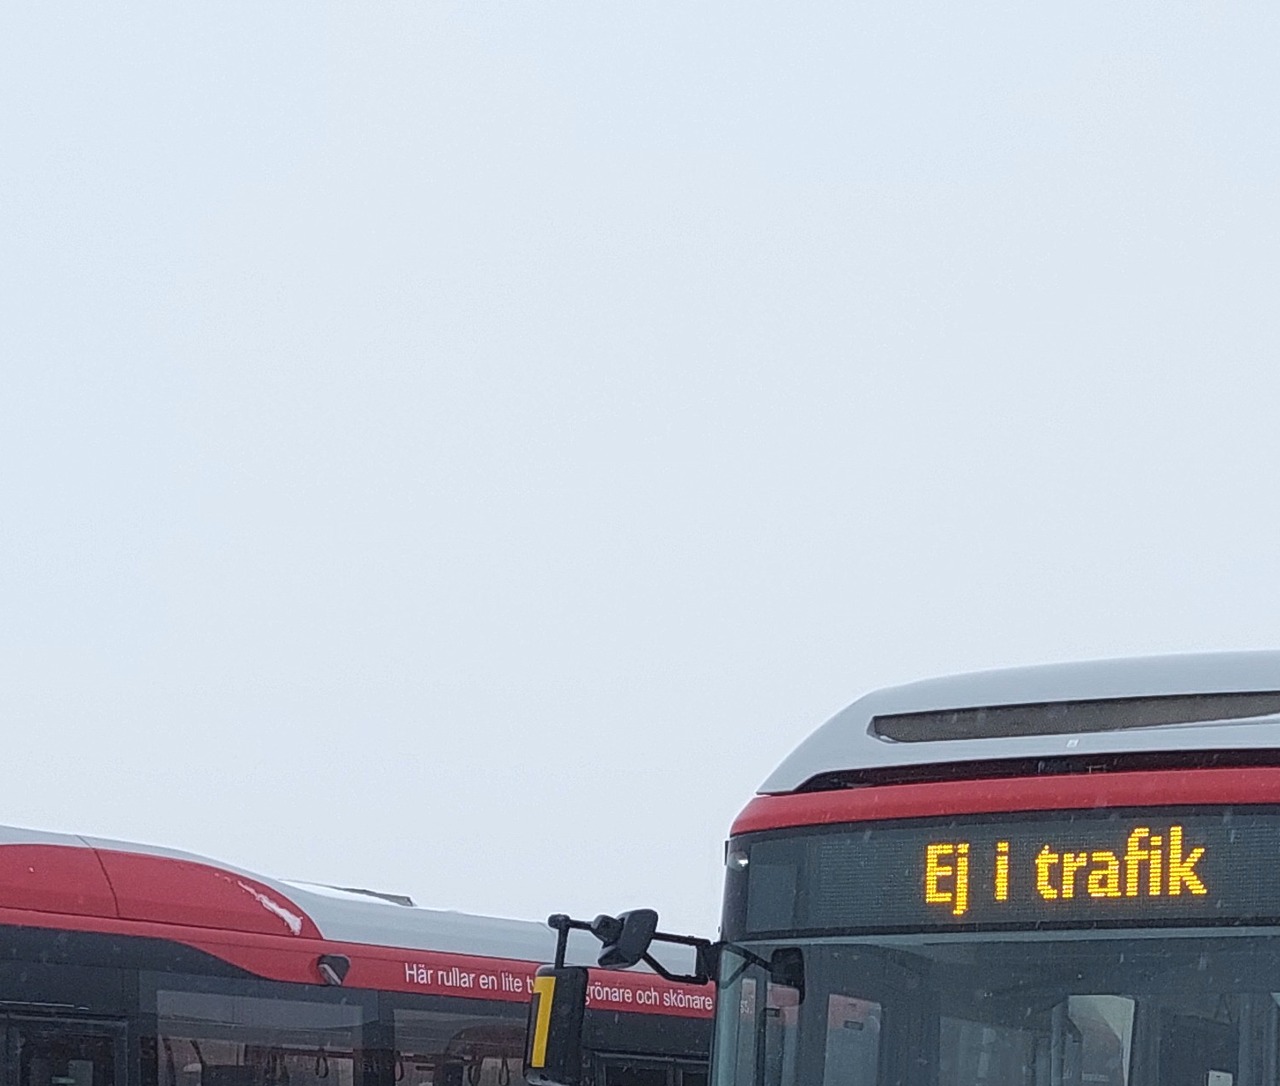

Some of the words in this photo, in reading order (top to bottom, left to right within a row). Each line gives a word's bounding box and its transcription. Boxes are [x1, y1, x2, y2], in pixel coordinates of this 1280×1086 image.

[926, 843, 969, 915] Ej
[995, 842, 1009, 900] i
[1035, 826, 1207, 899] trafik
[405, 963, 433, 984] Här
[438, 967, 475, 988] rullar
[480, 975, 497, 990] en
[502, 972, 522, 992] lite
[636, 988, 659, 1005] och
[663, 989, 713, 1010] skönare
